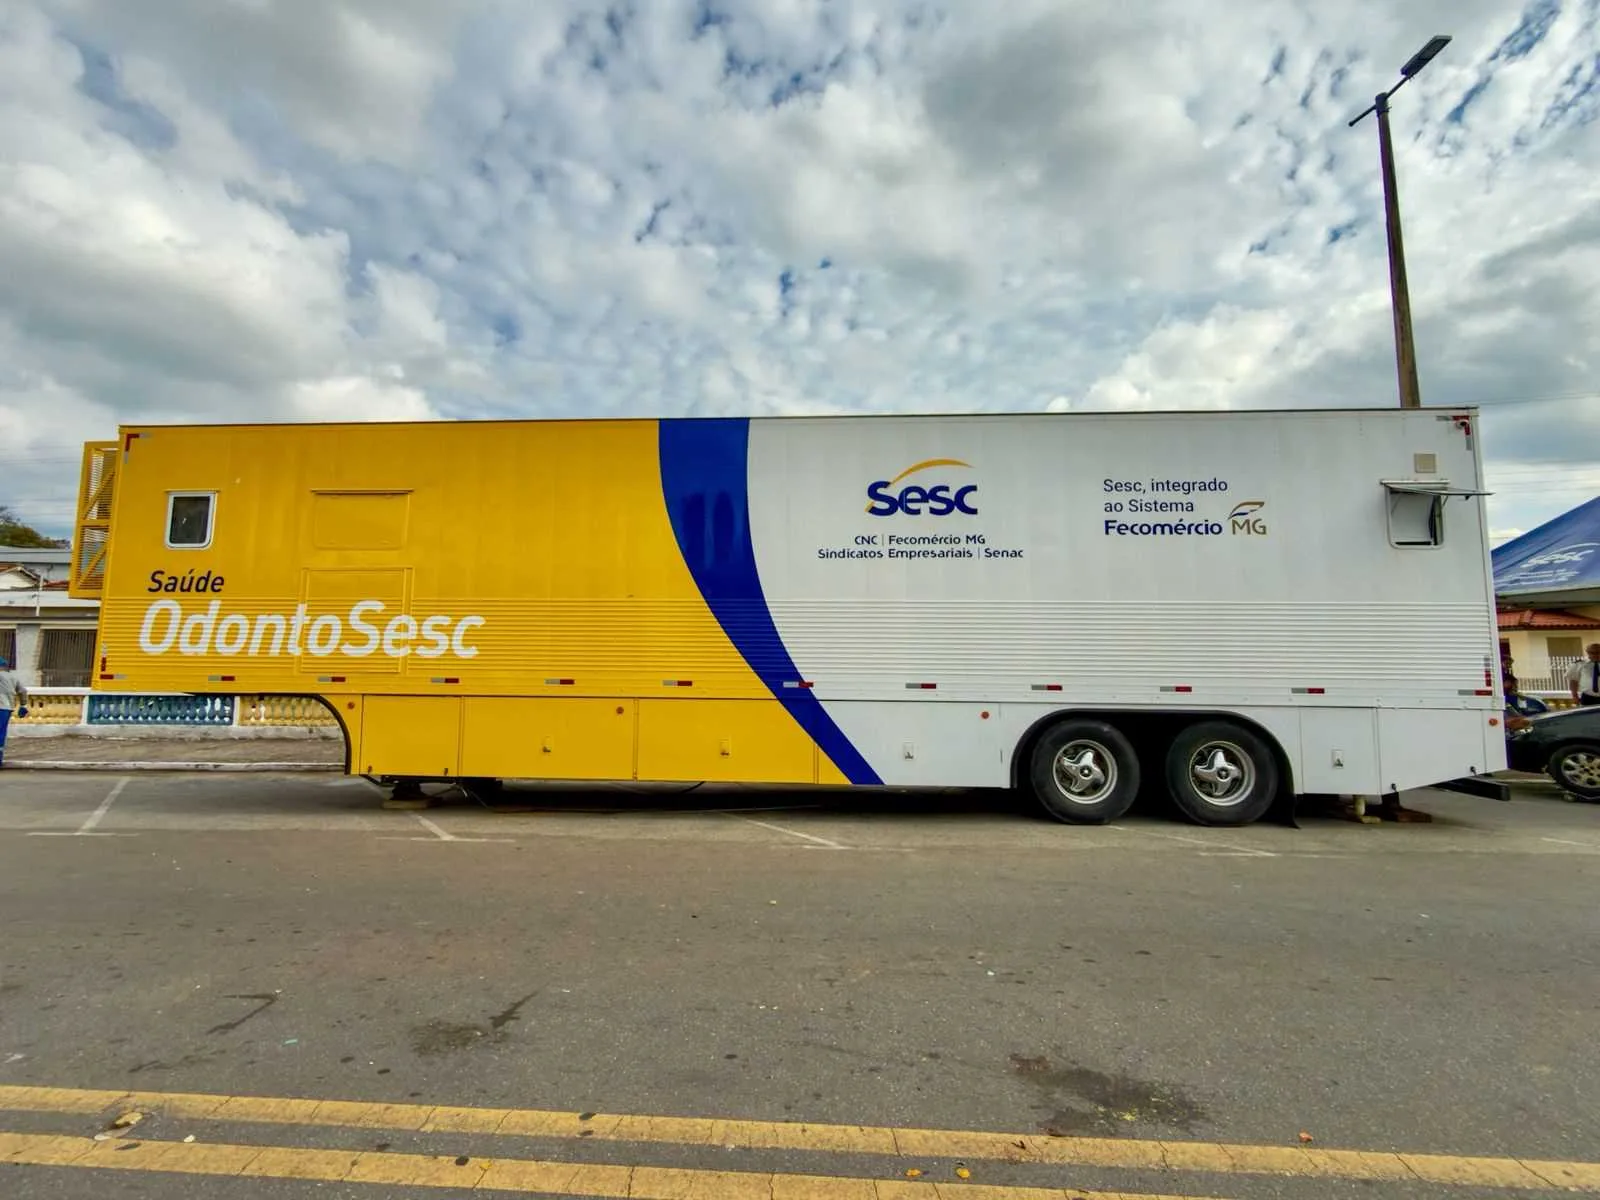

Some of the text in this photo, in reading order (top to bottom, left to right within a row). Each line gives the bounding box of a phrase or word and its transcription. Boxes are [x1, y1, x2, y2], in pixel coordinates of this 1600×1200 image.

[1103, 477, 1228, 495] Sesc, integrado
[865, 481, 978, 516] Sesc
[1104, 499, 1194, 513] ao Sistema
[1104, 518, 1267, 535] Fecomércio MG
[854, 533, 986, 545] CNC Fecomércio MG
[817, 548, 1024, 561] Sindicatos Empresariais Senac
[147, 568, 225, 593] Saúde
[137, 599, 486, 659] OdontoSesc
